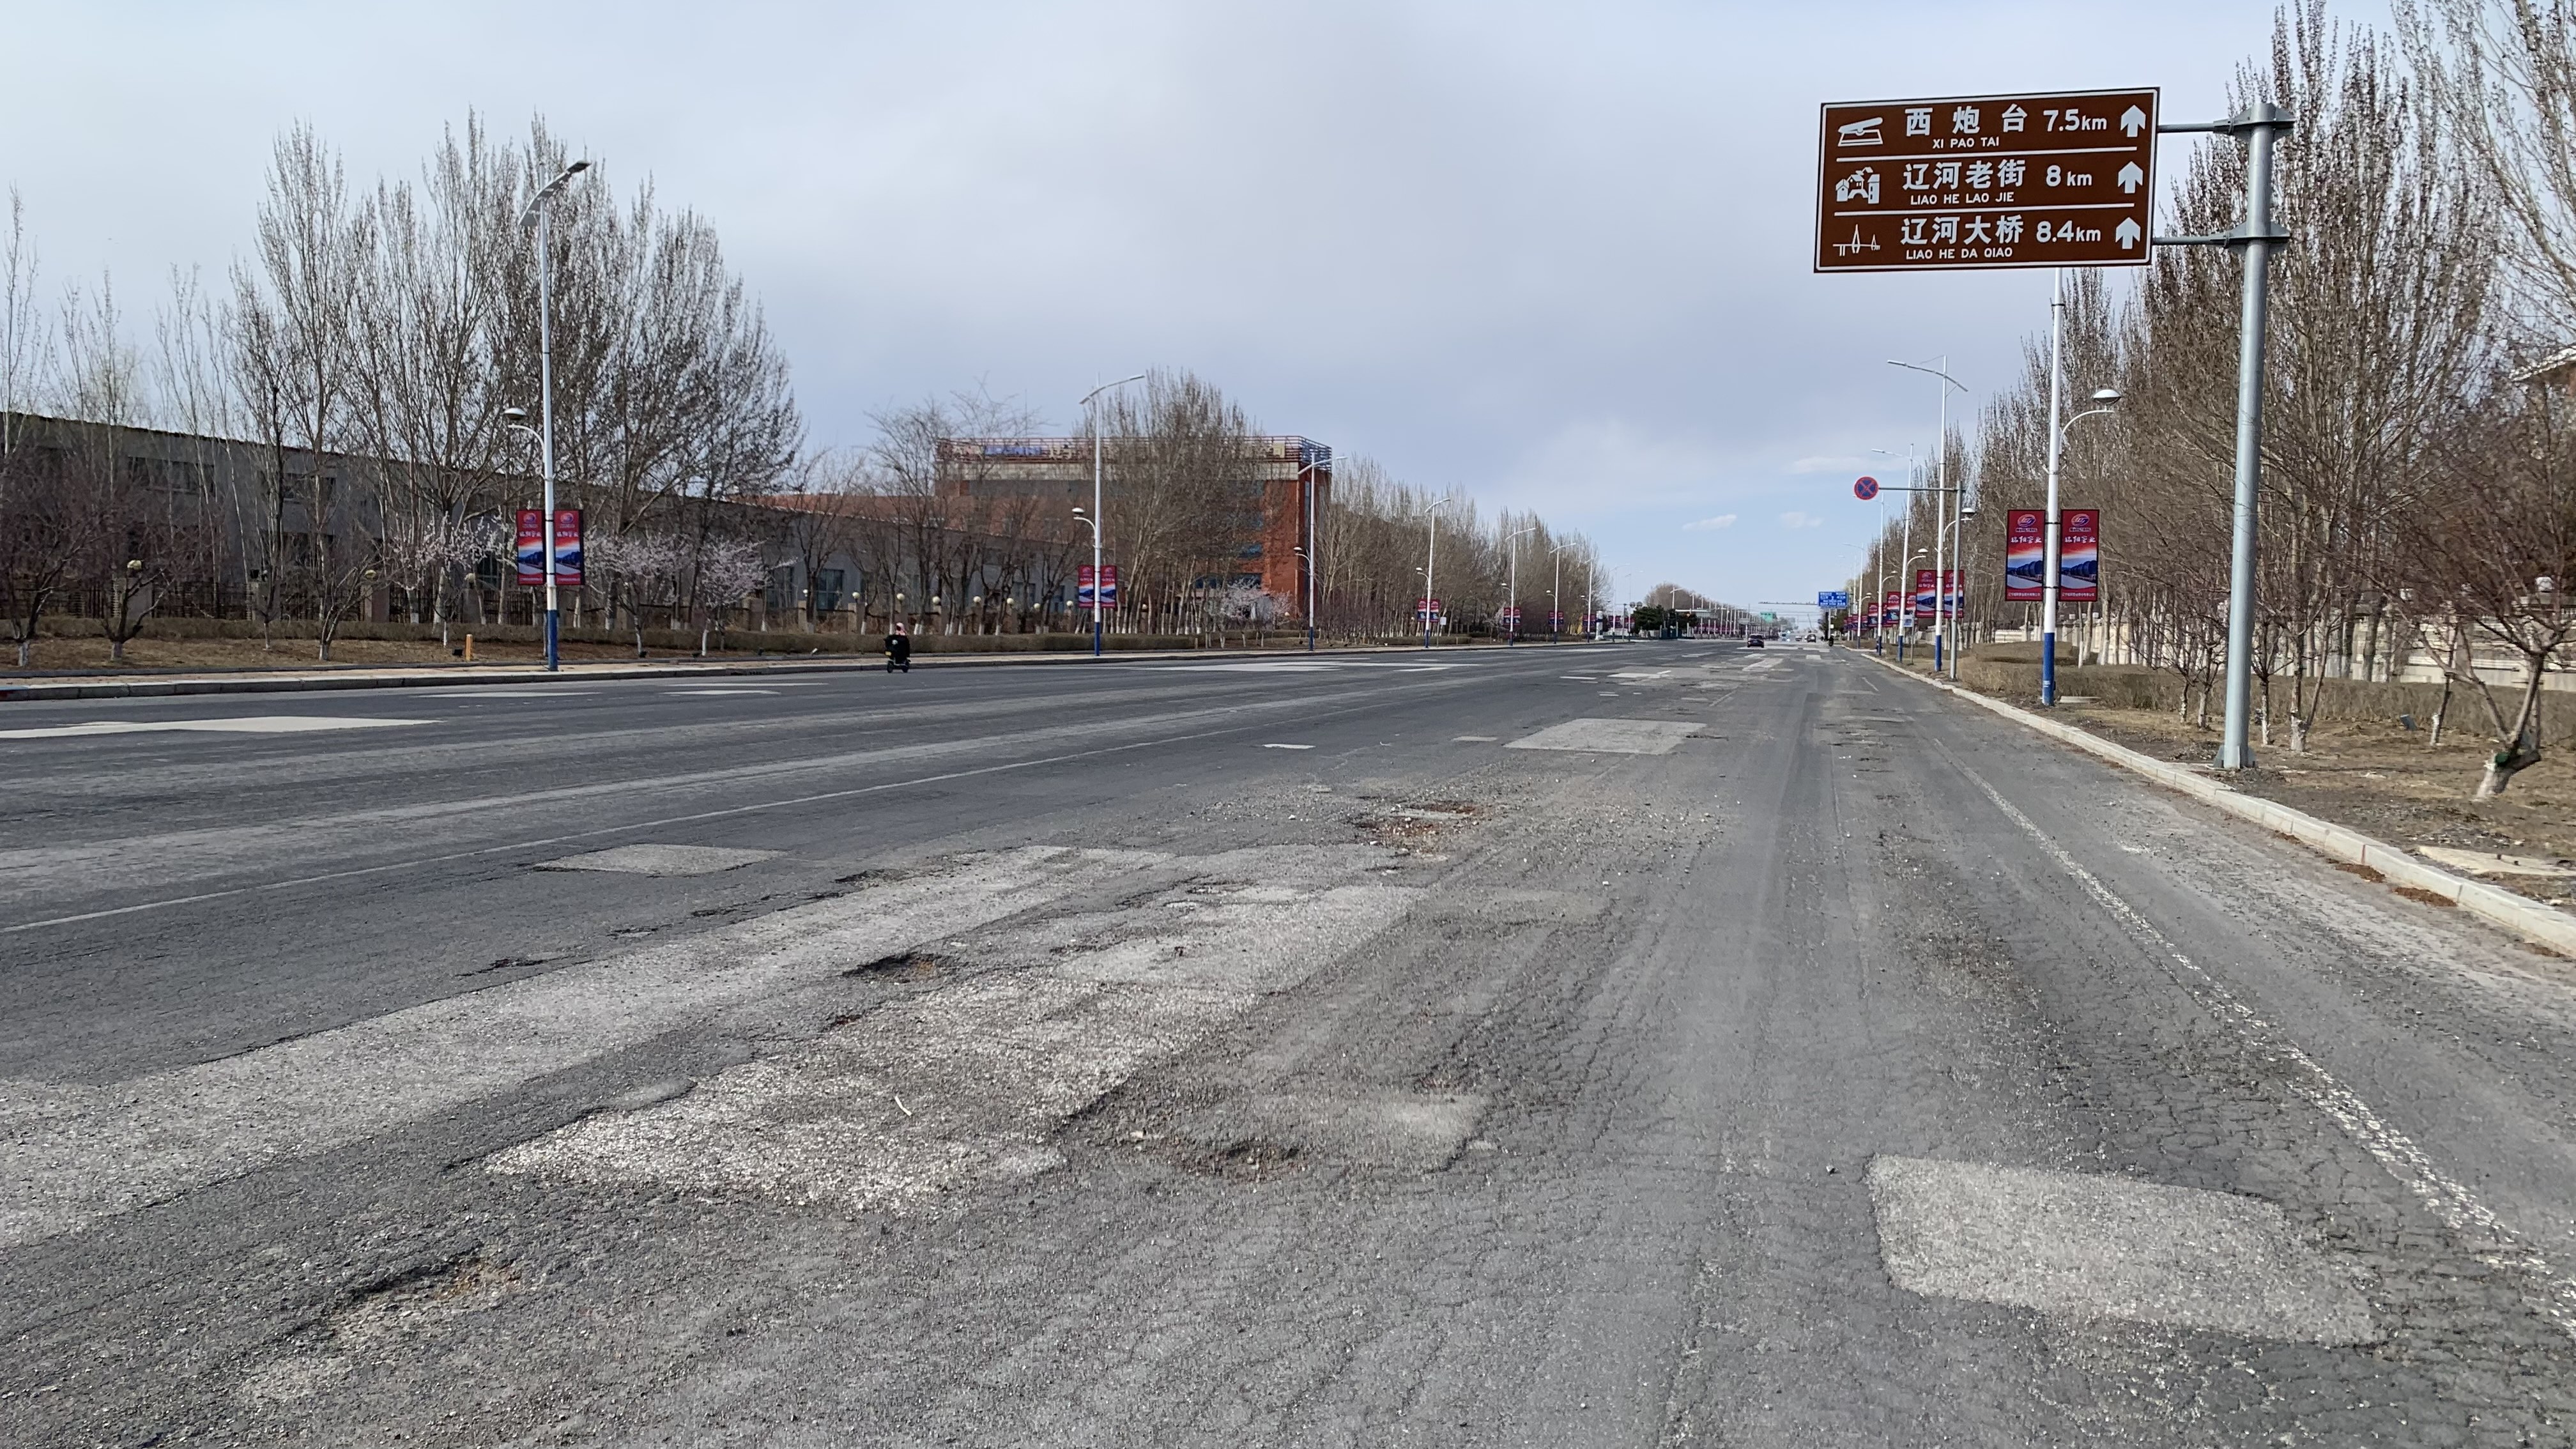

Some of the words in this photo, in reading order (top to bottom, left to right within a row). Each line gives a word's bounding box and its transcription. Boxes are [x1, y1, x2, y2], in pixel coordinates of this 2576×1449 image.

[1932, 138, 1944, 149] XI
[1950, 137, 1975, 149] PAO
[1980, 136, 2000, 147] TAI
[1903, 159, 2025, 190] 辽河老街
[2046, 165, 2061, 187] 8
[2066, 171, 2092, 187] km
[1910, 194, 1938, 205] LIAO
[1943, 193, 1960, 204] HE
[1965, 192, 1989, 204] LAO
[1995, 191, 2014, 203] JIE
[1901, 215, 2023, 245] 辽河大桥
[1906, 249, 1933, 260] LIAO
[1938, 249, 1956, 259] HE
[1961, 248, 1978, 259] DA
[1984, 247, 2013, 258] QIAO
